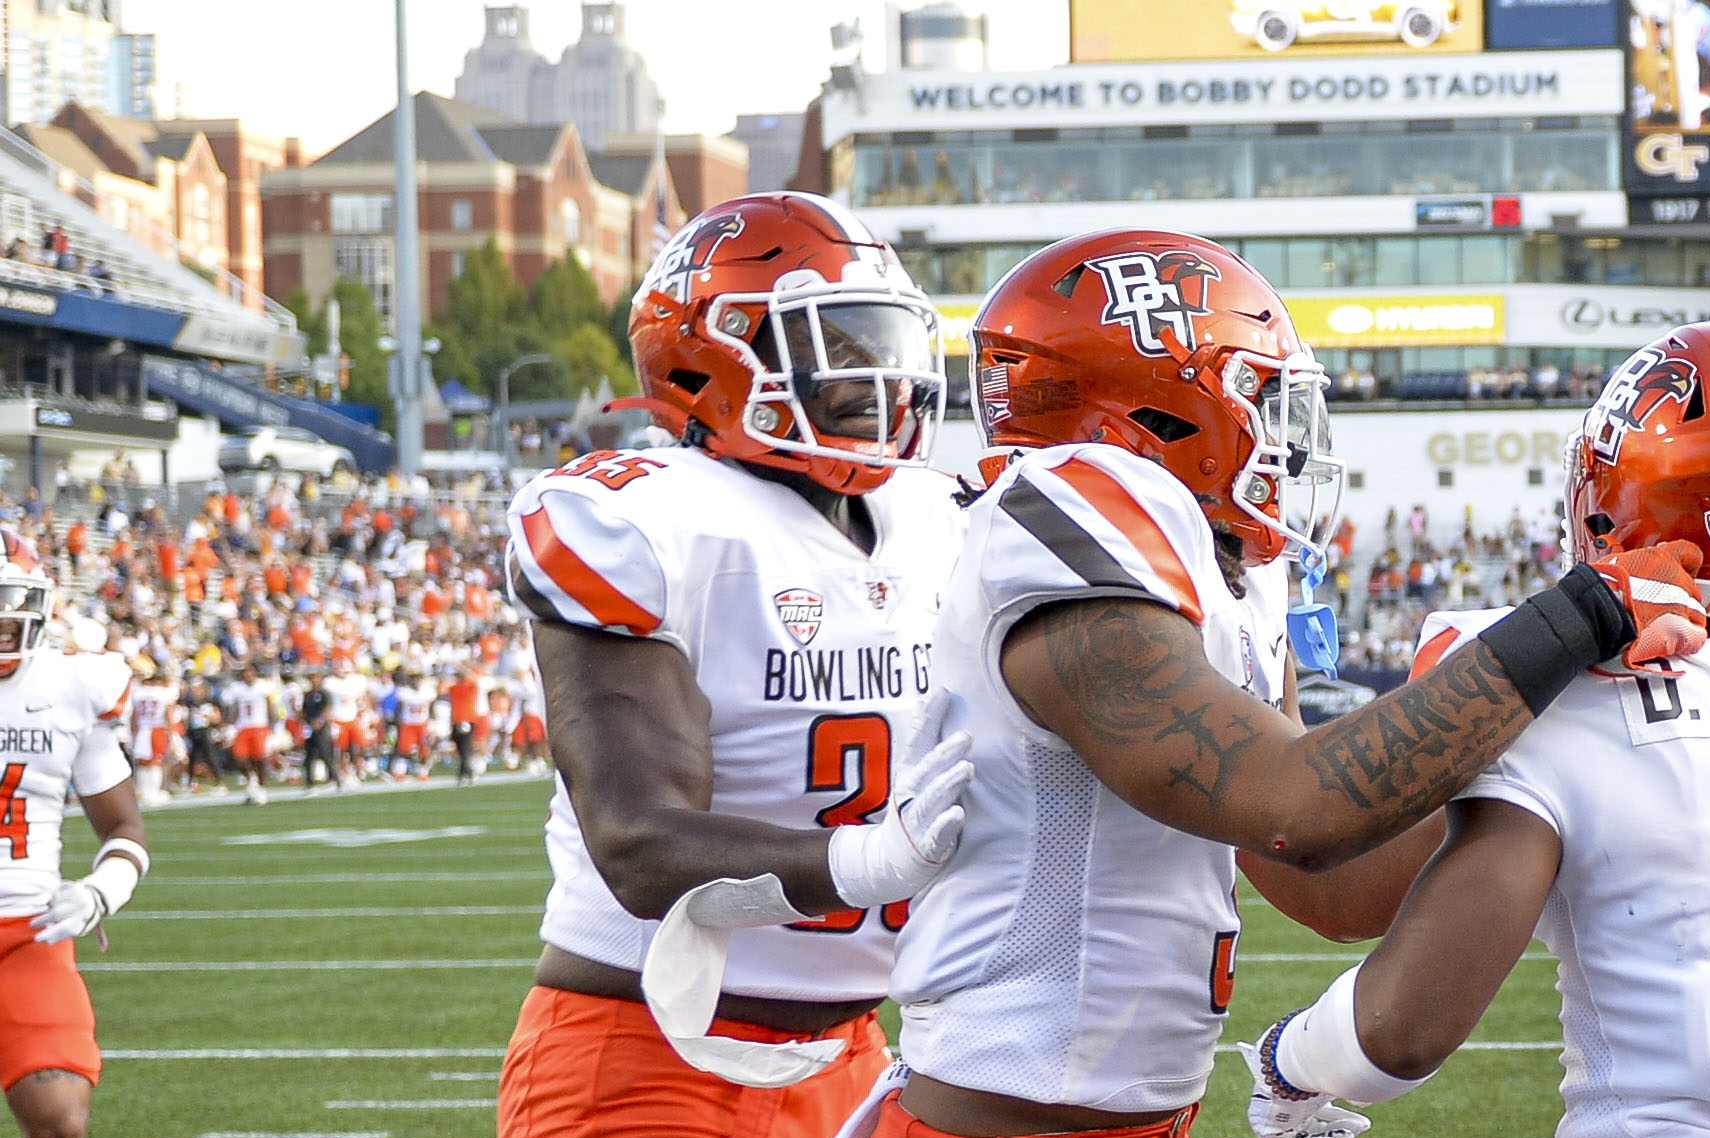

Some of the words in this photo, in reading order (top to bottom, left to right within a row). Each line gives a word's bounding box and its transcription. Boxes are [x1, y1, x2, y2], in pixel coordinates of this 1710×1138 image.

[910, 82, 1085, 109] WELCOME
[1098, 82, 1142, 105] TO
[1157, 79, 1275, 104] BOBBY
[1288, 77, 1390, 101] DODD
[1403, 72, 1560, 98] STADIUM
[1654, 201, 1700, 222] 1917
[1428, 431, 1566, 465] GEOR
[778, 604, 823, 623] MAC
[763, 646, 903, 702] BOWLING
